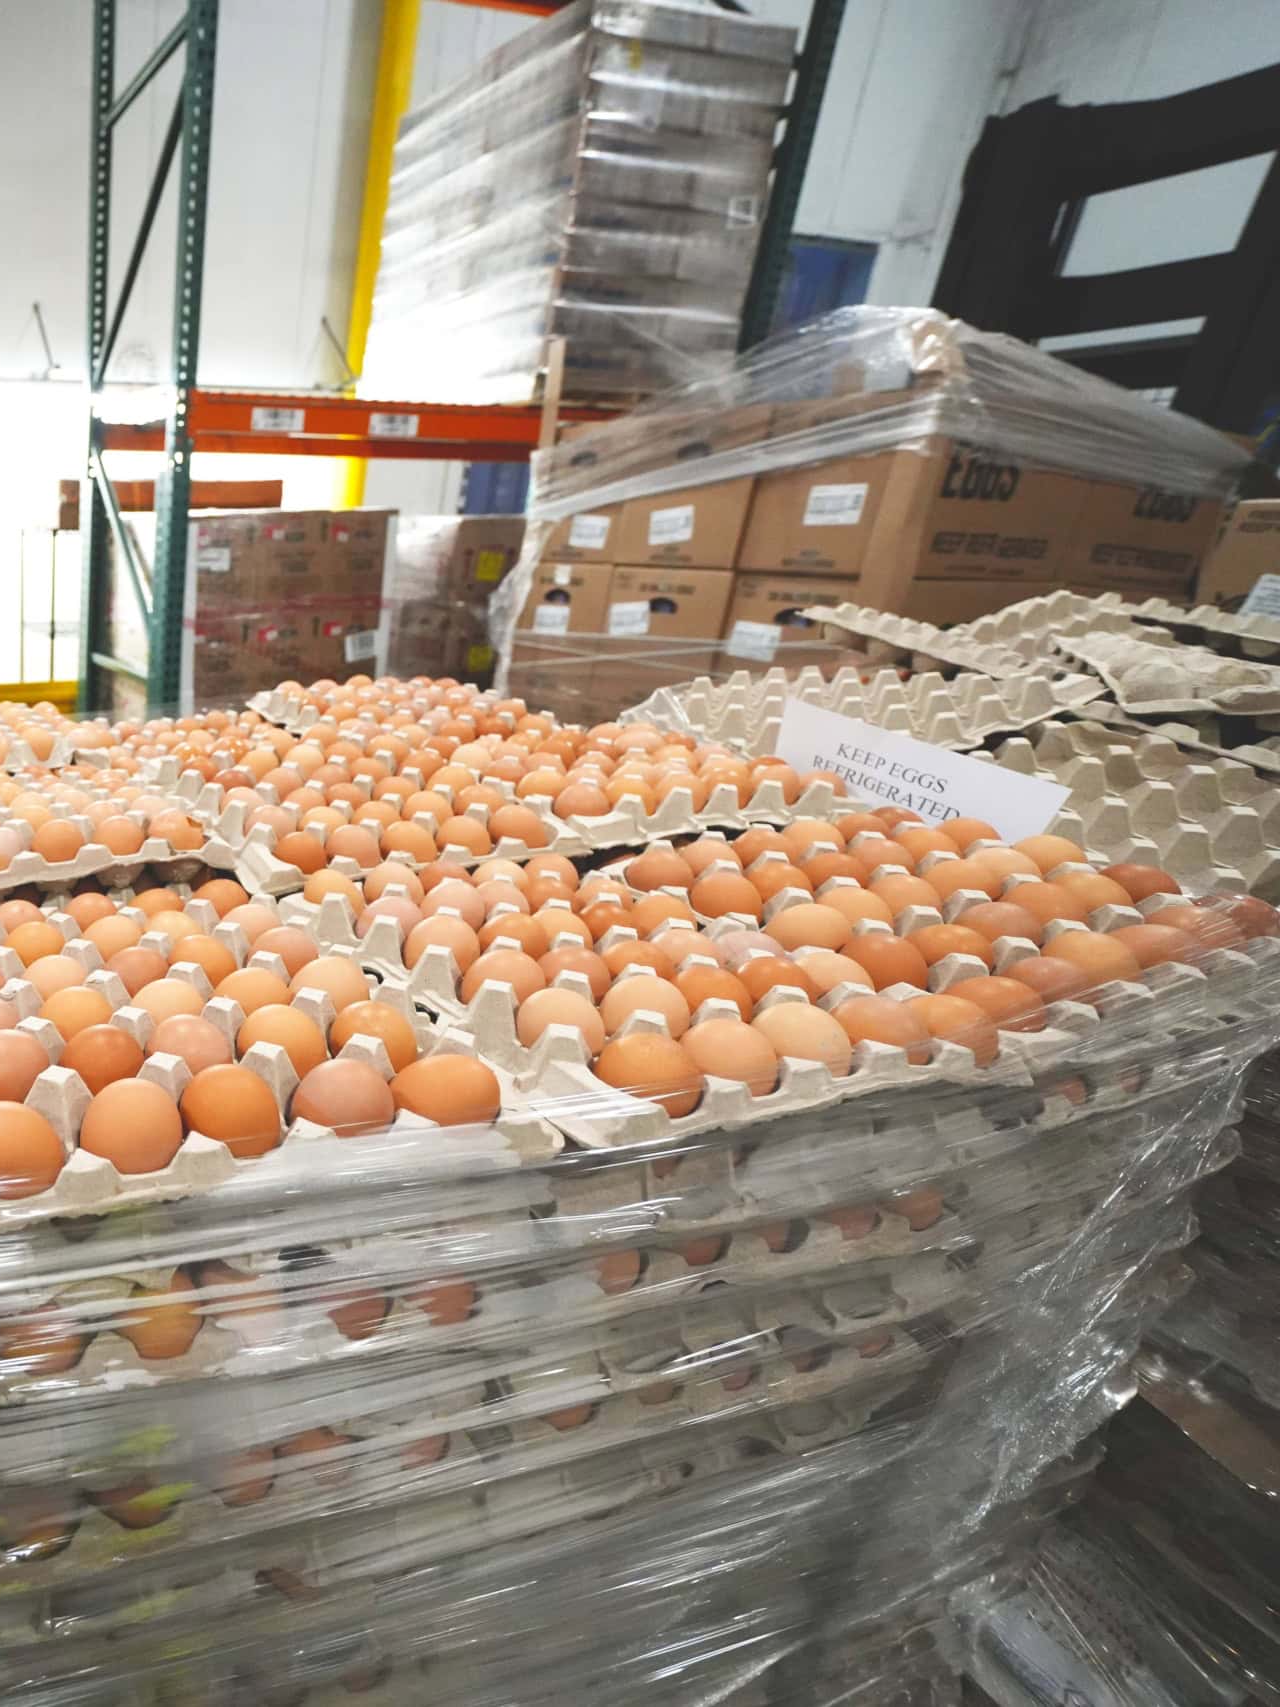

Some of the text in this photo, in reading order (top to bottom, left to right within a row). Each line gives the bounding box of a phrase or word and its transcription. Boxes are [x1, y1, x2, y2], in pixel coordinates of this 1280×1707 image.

[812, 755, 961, 821] REFRIGERATED
[836, 743, 948, 794] KEEP EGGS
